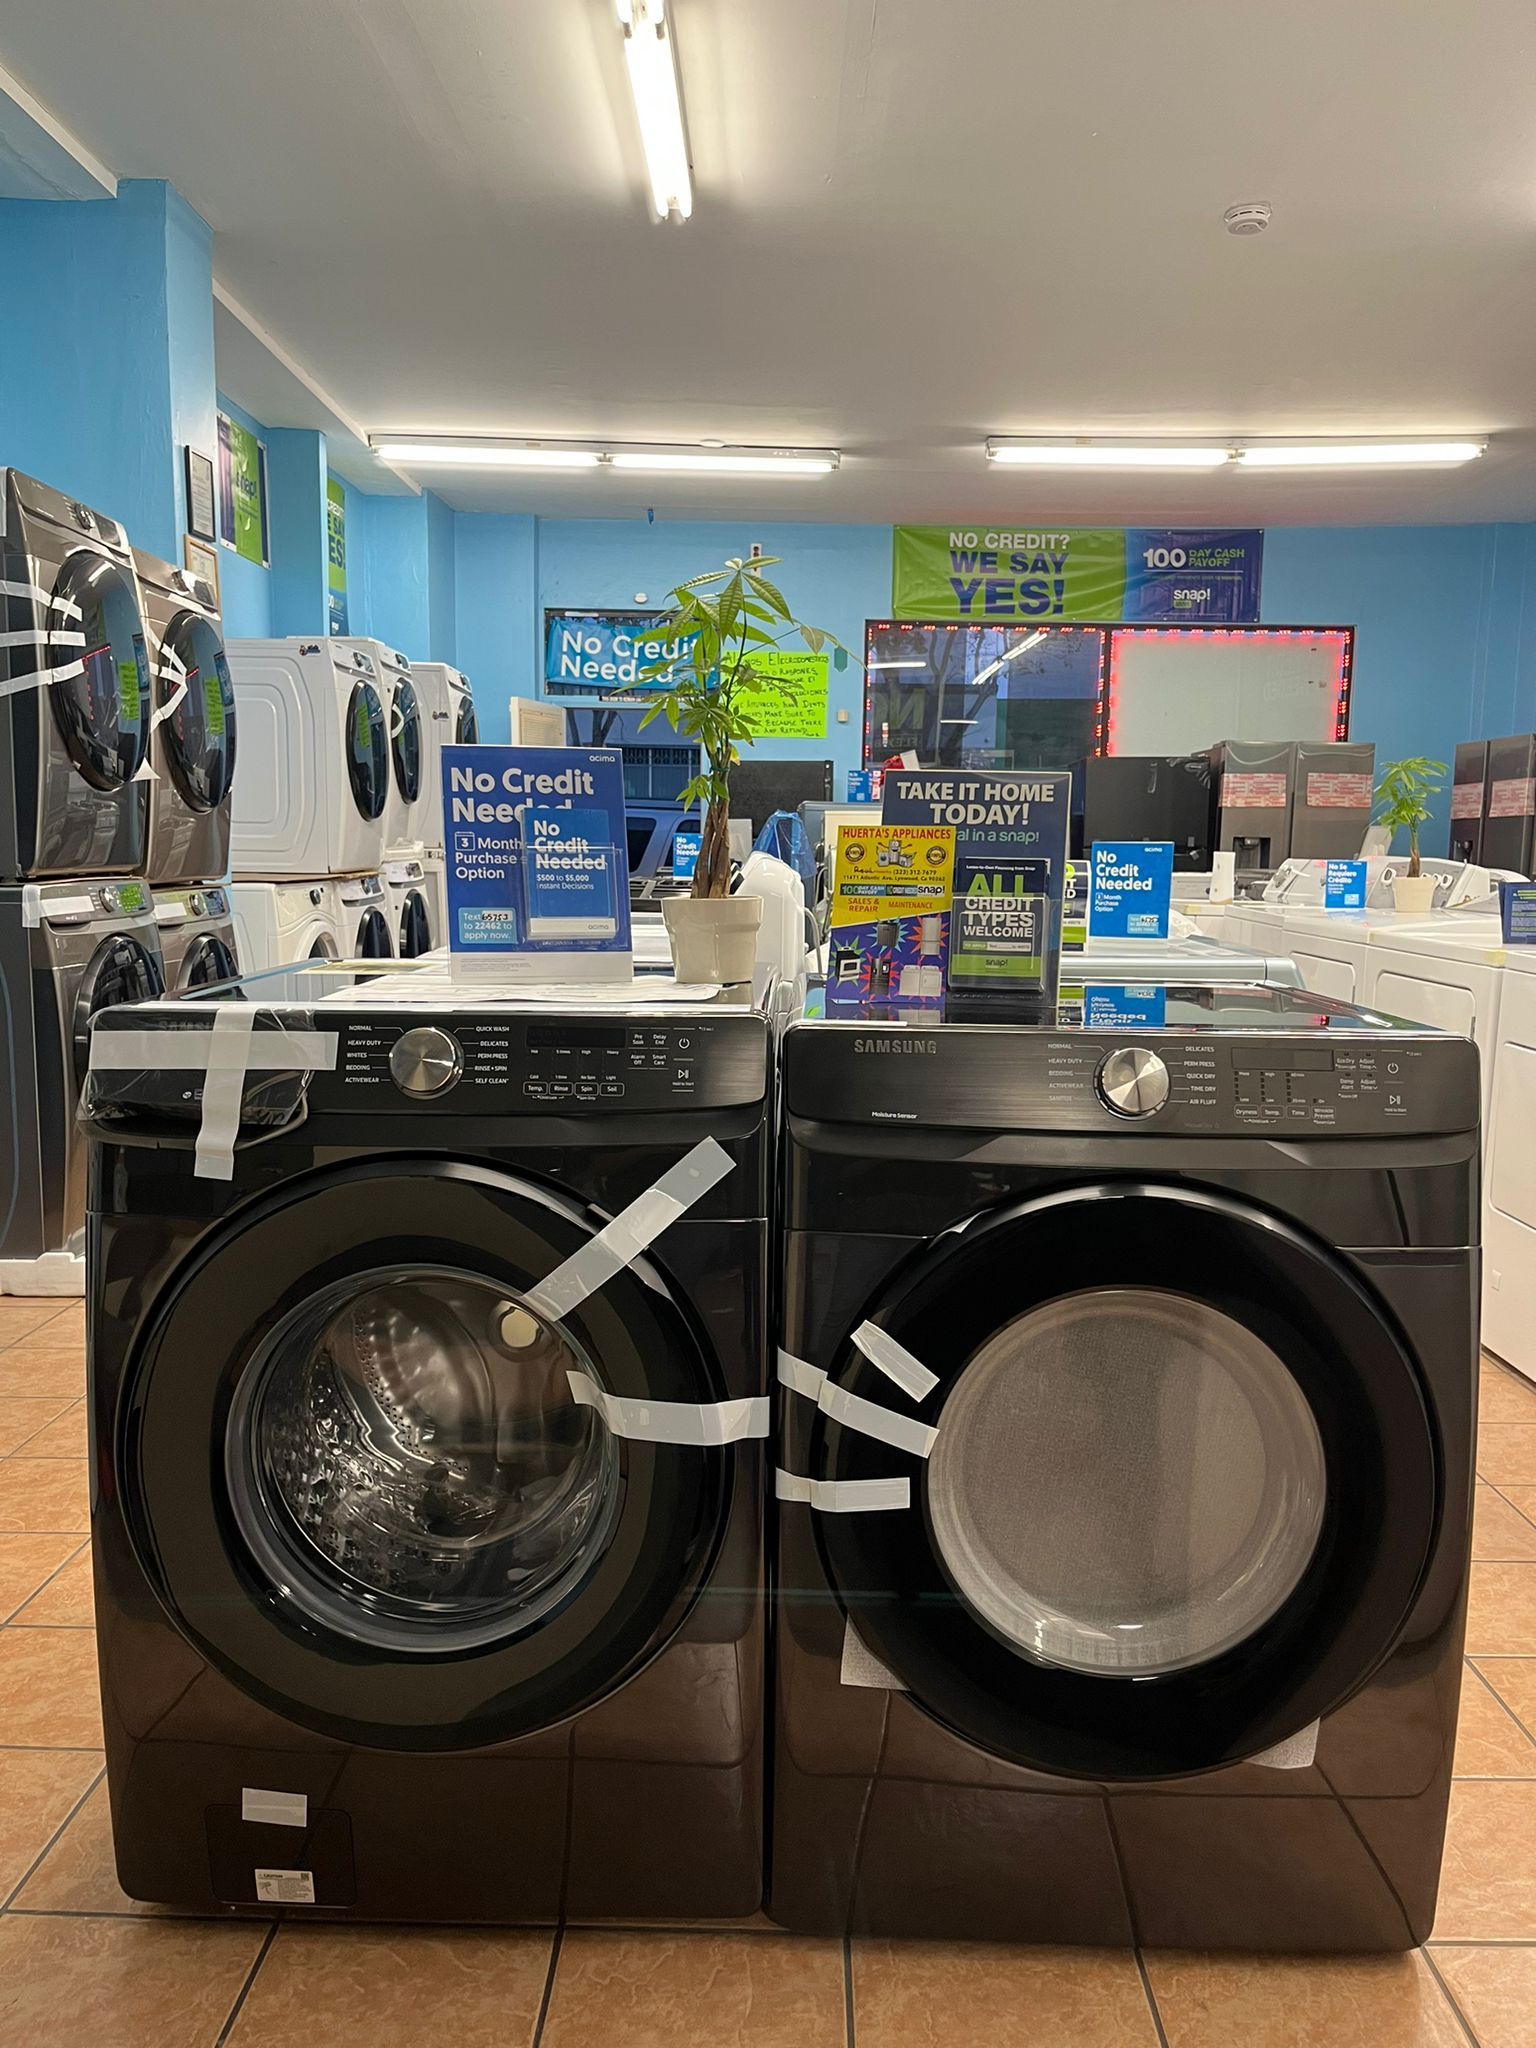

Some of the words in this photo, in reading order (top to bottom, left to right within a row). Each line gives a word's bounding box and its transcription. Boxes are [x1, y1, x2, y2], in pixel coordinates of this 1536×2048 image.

[949, 532, 978, 550] NO
[984, 533, 1070, 551] CREDIT?
[949, 551, 999, 574] WE
[1009, 553, 1069, 575] SAY
[1143, 548, 1186, 568] 100
[1189, 549, 1211, 557] DAY
[1215, 549, 1245, 558] CASH
[1189, 558, 1231, 567] PAYOFF
[949, 578, 1065, 615] YES!
[1174, 588, 1211, 603] snap!
[562, 630, 602, 654] No
[450, 767, 496, 793] No
[502, 768, 594, 795] Credit
[897, 782, 953, 800] TAKE
[958, 783, 980, 801] IT
[983, 783, 1054, 802] HOME
[930, 803, 1029, 825] TODAY!
[533, 820, 560, 836] No
[843, 828, 889, 838] HUERTA'S
[892, 829, 951, 839] APPLIANCES
[461, 838, 469, 847] 3
[477, 838, 522, 850] Month
[534, 837, 589, 853] Credit
[972, 829, 984, 841] in
[987, 832, 996, 841] a
[1000, 832, 1039, 848] snap!
[455, 853, 517, 864] Purchase
[536, 854, 606, 870] Needed
[1096, 850, 1117, 863] No
[456, 867, 505, 880] Option
[565, 874, 589, 882] $5,000
[1096, 864, 1139, 877] Credit
[917, 886, 945, 896] snap!
[967, 874, 1034, 898] ALL
[1096, 877, 1153, 890] Needed
[965, 898, 1034, 911] CREDIT
[965, 911, 1033, 927] TYPES
[464, 931, 488, 940] apply
[963, 926, 1033, 937] WELCOME
[854, 1040, 937, 1053] SAMSUNG
